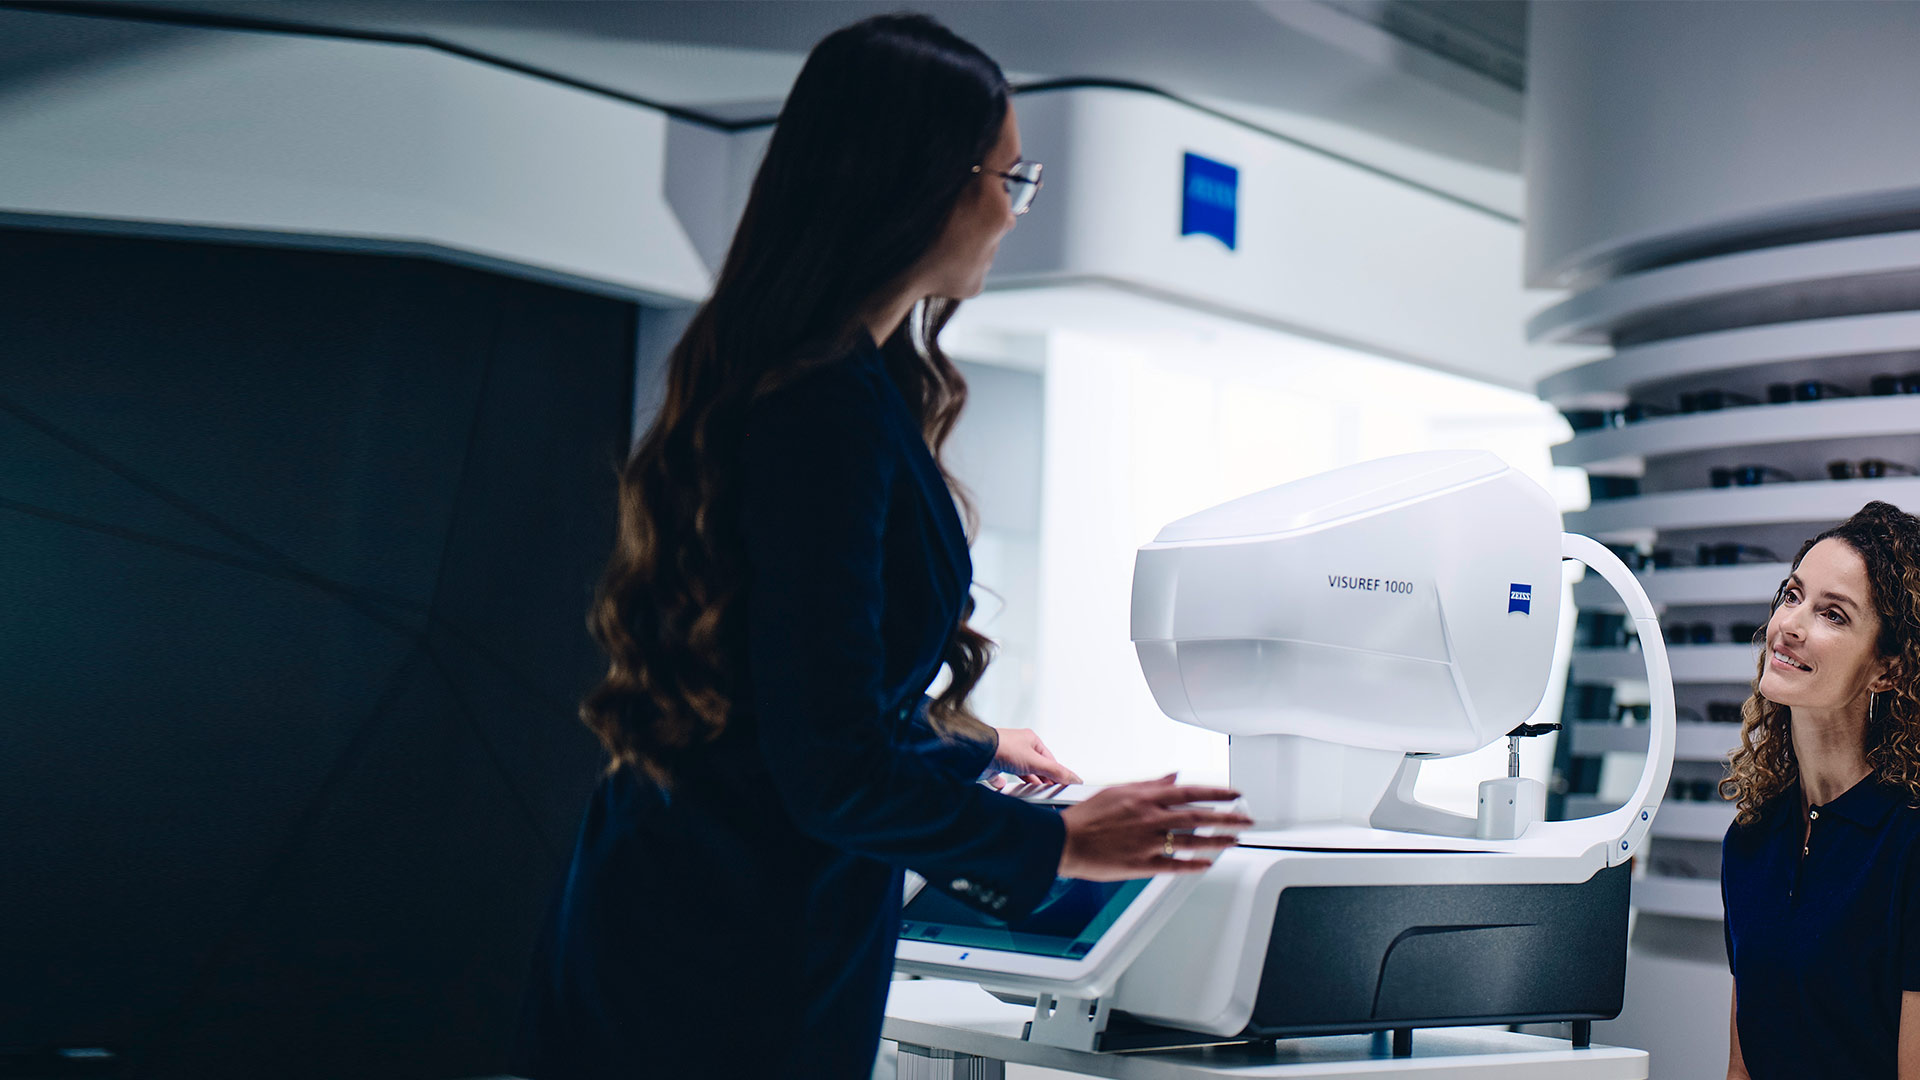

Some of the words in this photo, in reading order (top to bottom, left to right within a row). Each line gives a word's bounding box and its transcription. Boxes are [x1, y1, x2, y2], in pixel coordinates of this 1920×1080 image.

[1328, 575, 1380, 591] VISUREF
[1385, 580, 1413, 594] 1000
[1510, 591, 1530, 600] ZEISS
